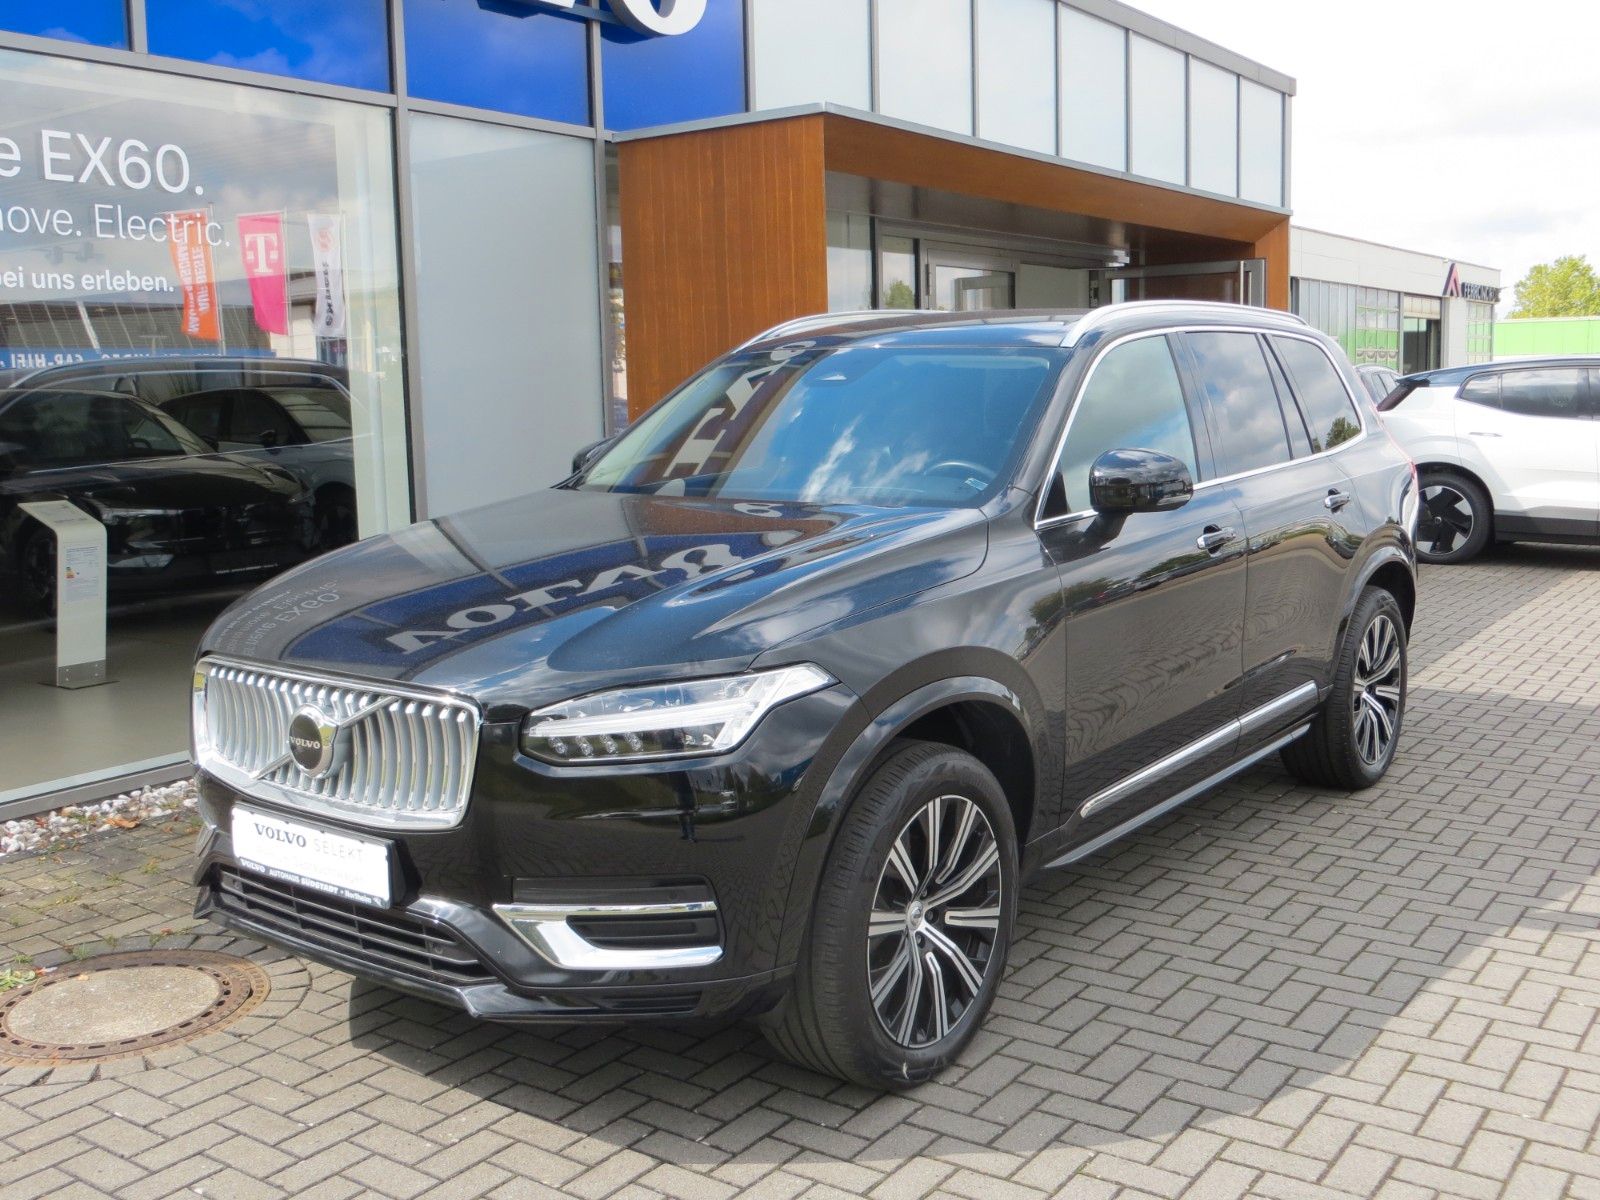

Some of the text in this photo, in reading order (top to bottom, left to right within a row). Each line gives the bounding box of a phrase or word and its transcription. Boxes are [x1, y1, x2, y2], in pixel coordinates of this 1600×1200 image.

[41, 129, 204, 196] EX60.
[0, 203, 231, 247] ove. Electric.
[0, 265, 175, 293] ei uns erleben.
[289, 736, 321, 749] VOLVO
[254, 822, 307, 848] VOLVO
[239, 858, 267, 873] VOLVO
